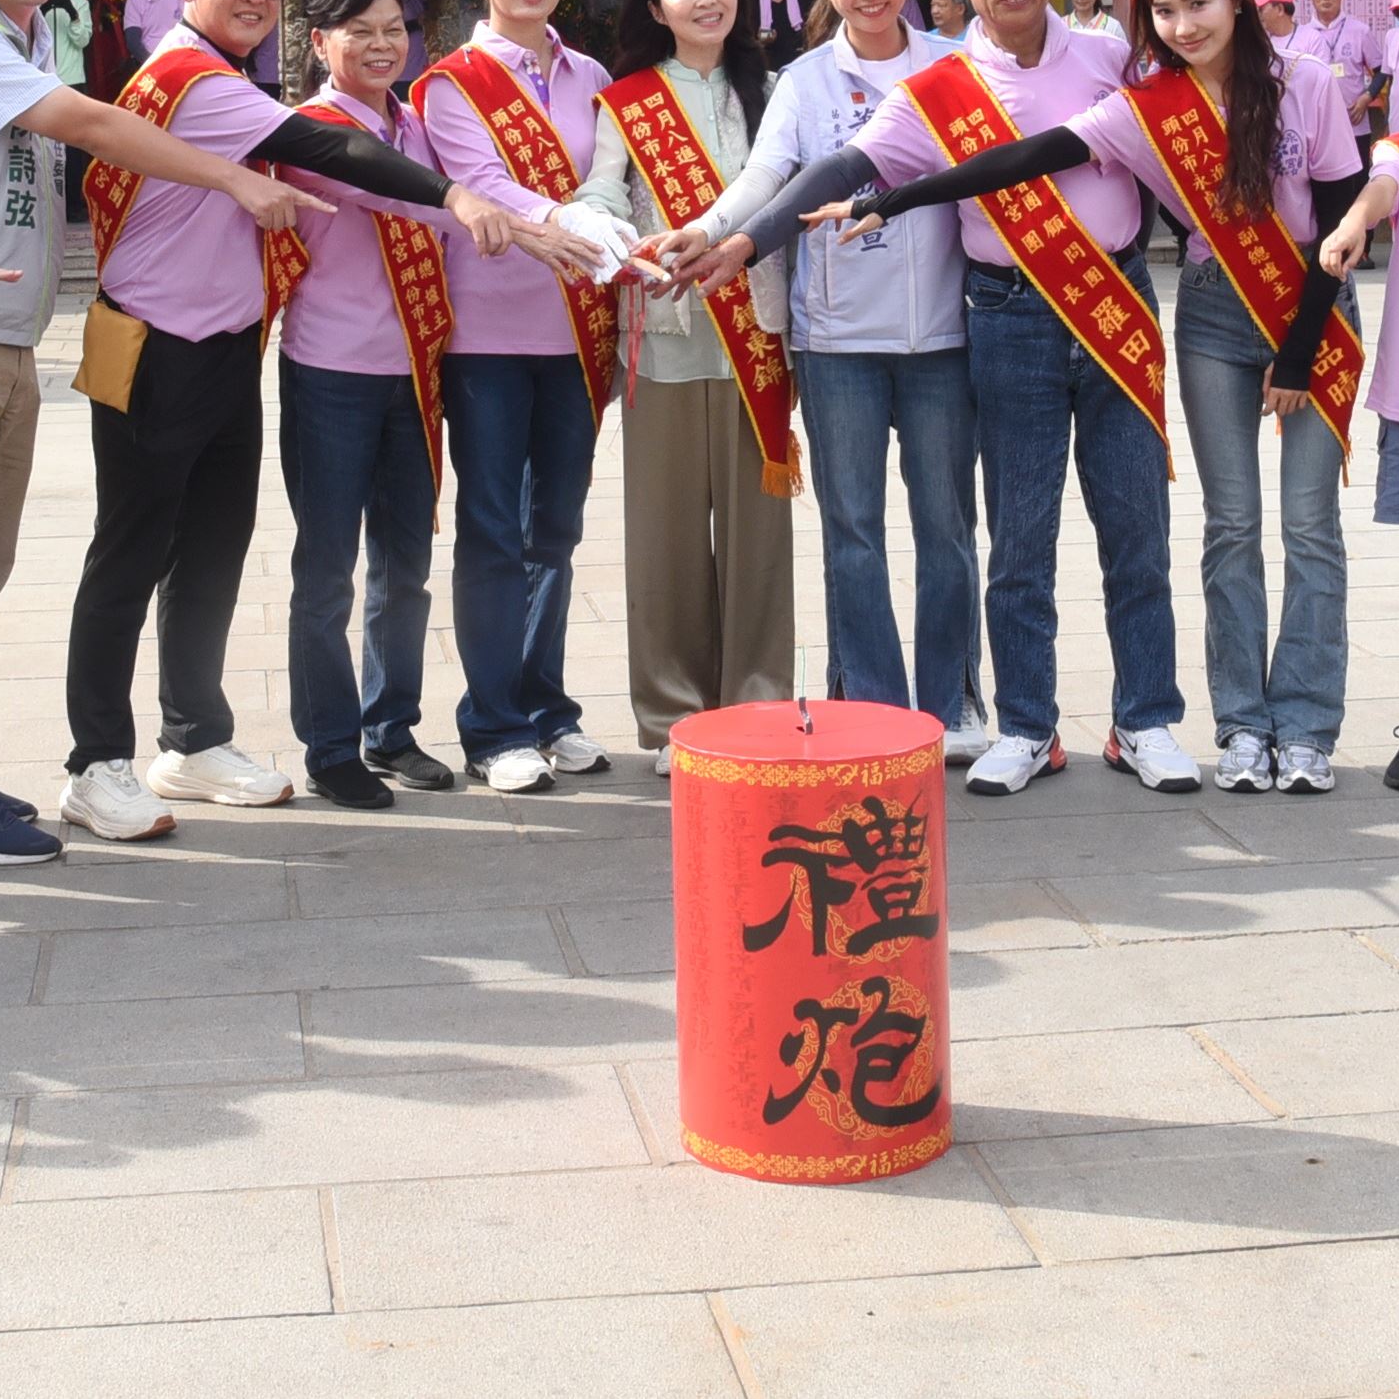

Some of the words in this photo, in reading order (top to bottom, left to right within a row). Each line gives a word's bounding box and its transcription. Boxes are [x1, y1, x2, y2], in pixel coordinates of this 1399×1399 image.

[621, 102, 692, 218] 頭份市永貞宮
[643, 91, 719, 207] 四月八進香團
[1043, 214, 1105, 288] 顧問團
[400, 270, 432, 341] 頭份市長
[1089, 295, 1165, 400] 羅田春
[861, 760, 883, 787] 福
[742, 795, 942, 1128] 禮炮
[869, 1149, 891, 1176] 福
